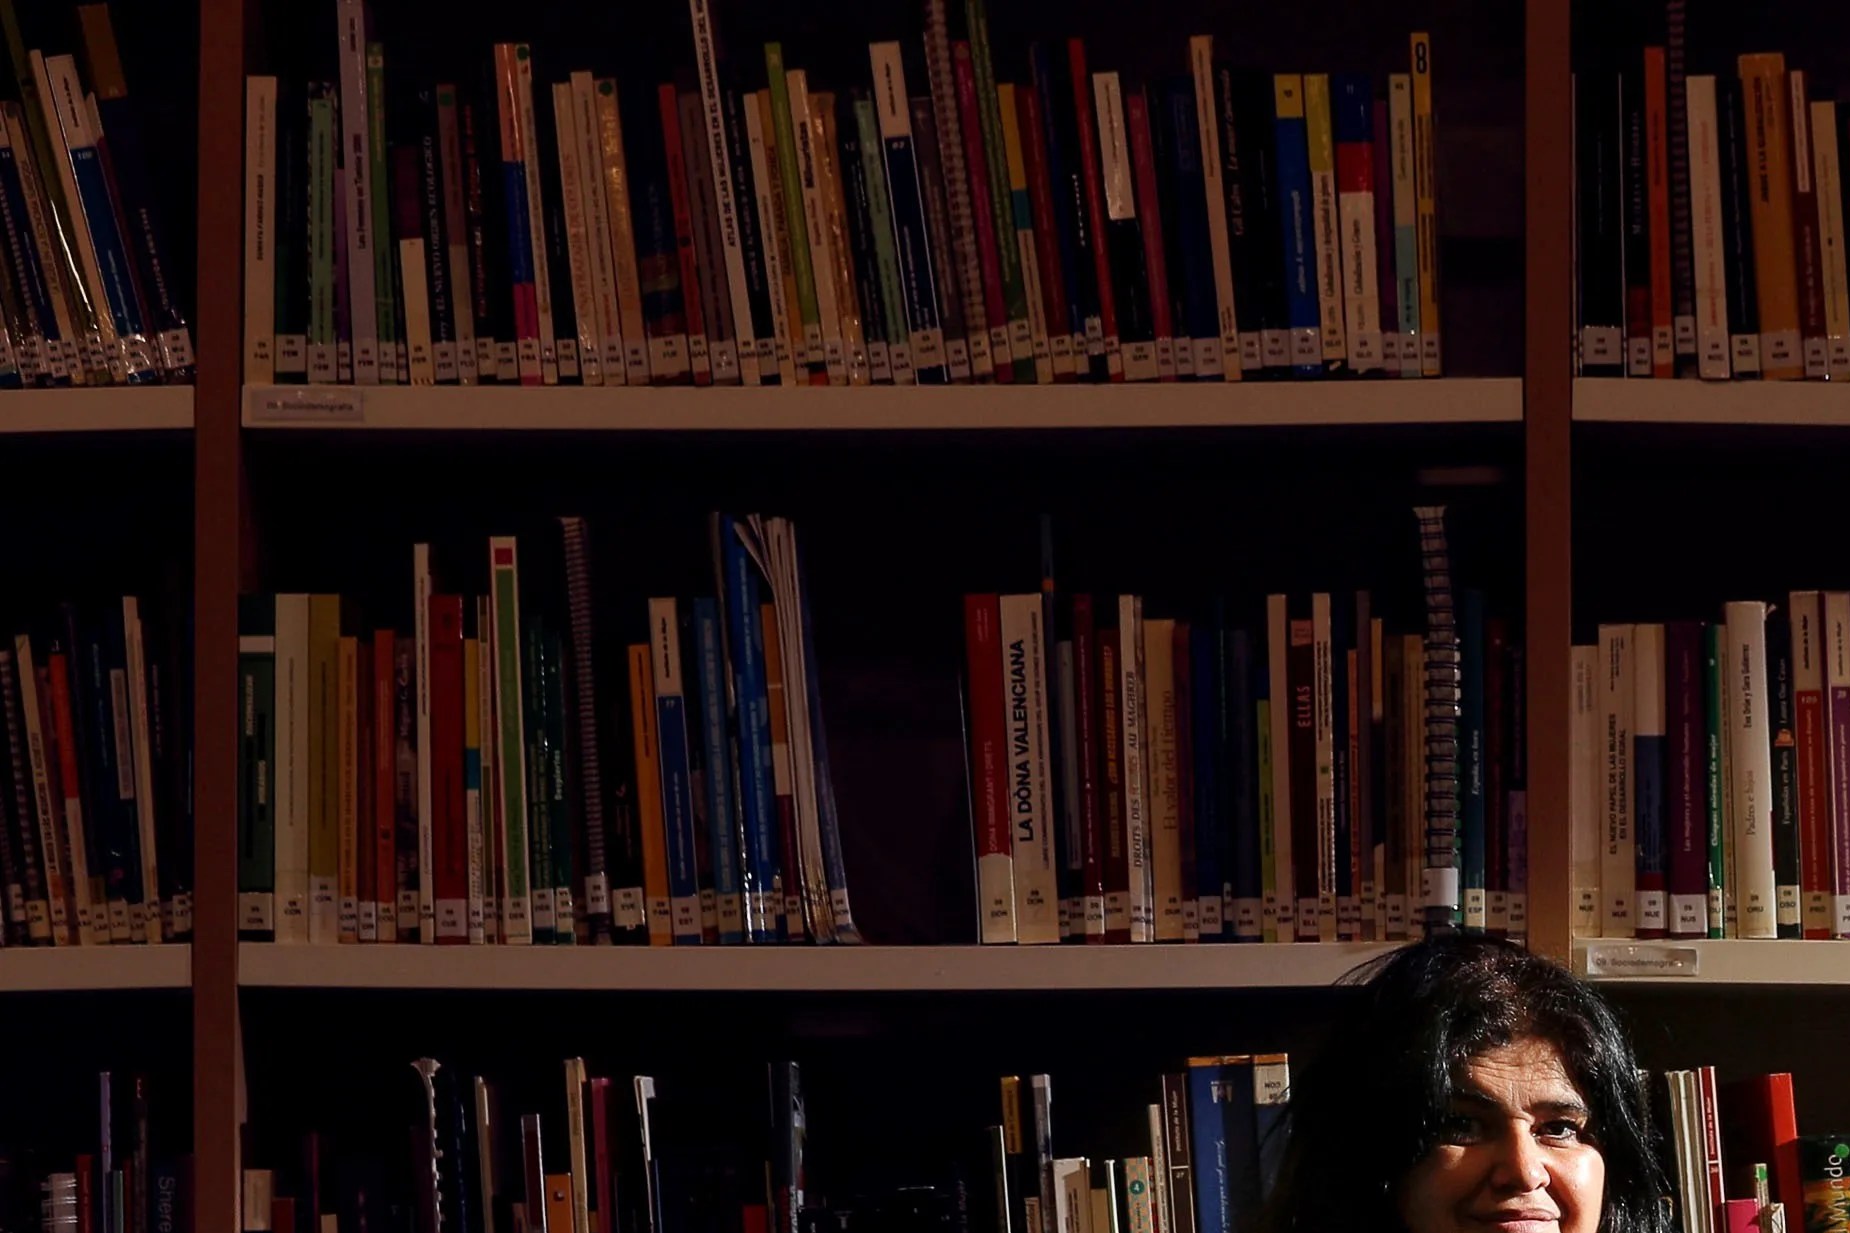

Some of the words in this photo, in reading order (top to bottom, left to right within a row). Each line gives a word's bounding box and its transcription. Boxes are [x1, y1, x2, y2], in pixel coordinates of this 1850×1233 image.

[1009, 639, 1029, 755] VALENCIANA
[1296, 685, 1311, 728] ELLAS
[1011, 761, 1031, 813] DÒNA
[1017, 818, 1034, 842] LA
[156, 1176, 176, 1233] Shere
[1825, 1154, 1845, 1222] Mundo
